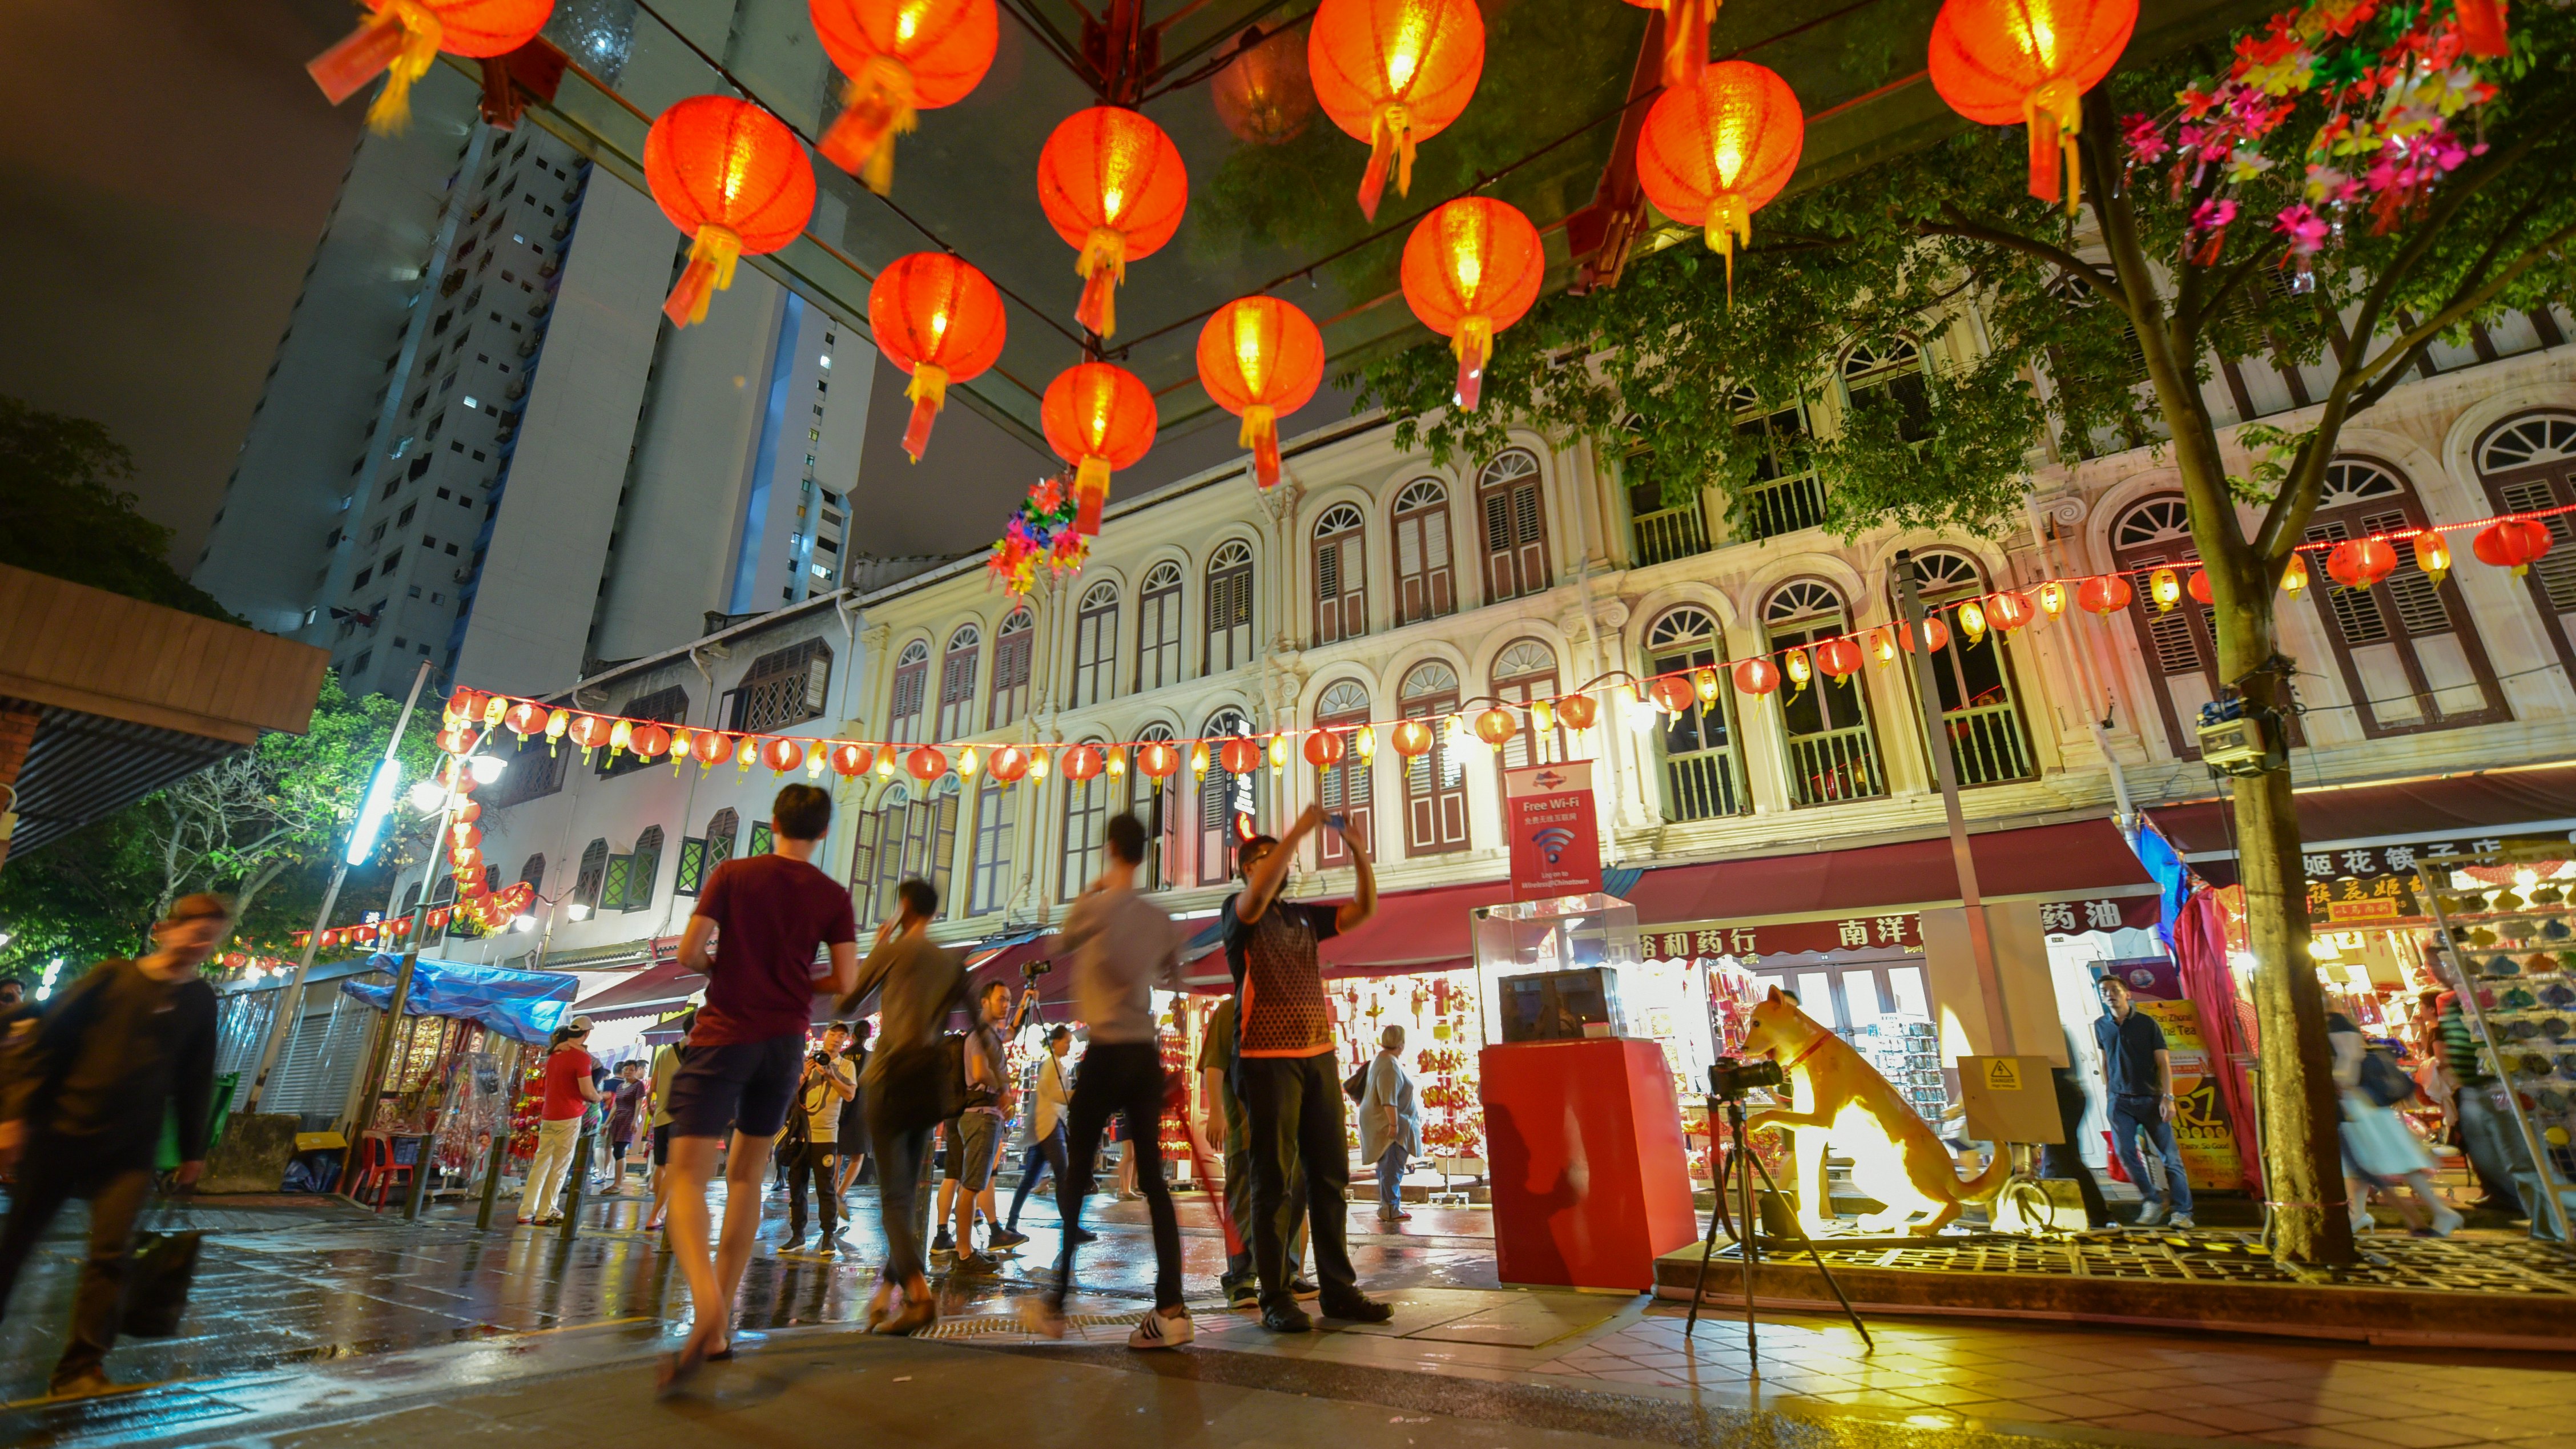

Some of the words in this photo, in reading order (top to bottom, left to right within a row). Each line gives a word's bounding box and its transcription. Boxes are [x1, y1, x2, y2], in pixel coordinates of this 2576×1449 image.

[1523, 801, 1548, 812] Free
[1549, 796, 1580, 810] Wi-Fi
[1524, 813, 1577, 825] 免费无线互联网
[1521, 879, 1589, 889] Wireless@Chinatown
[2040, 899, 2123, 932] 药油
[2176, 1024, 2197, 1036] Tea
